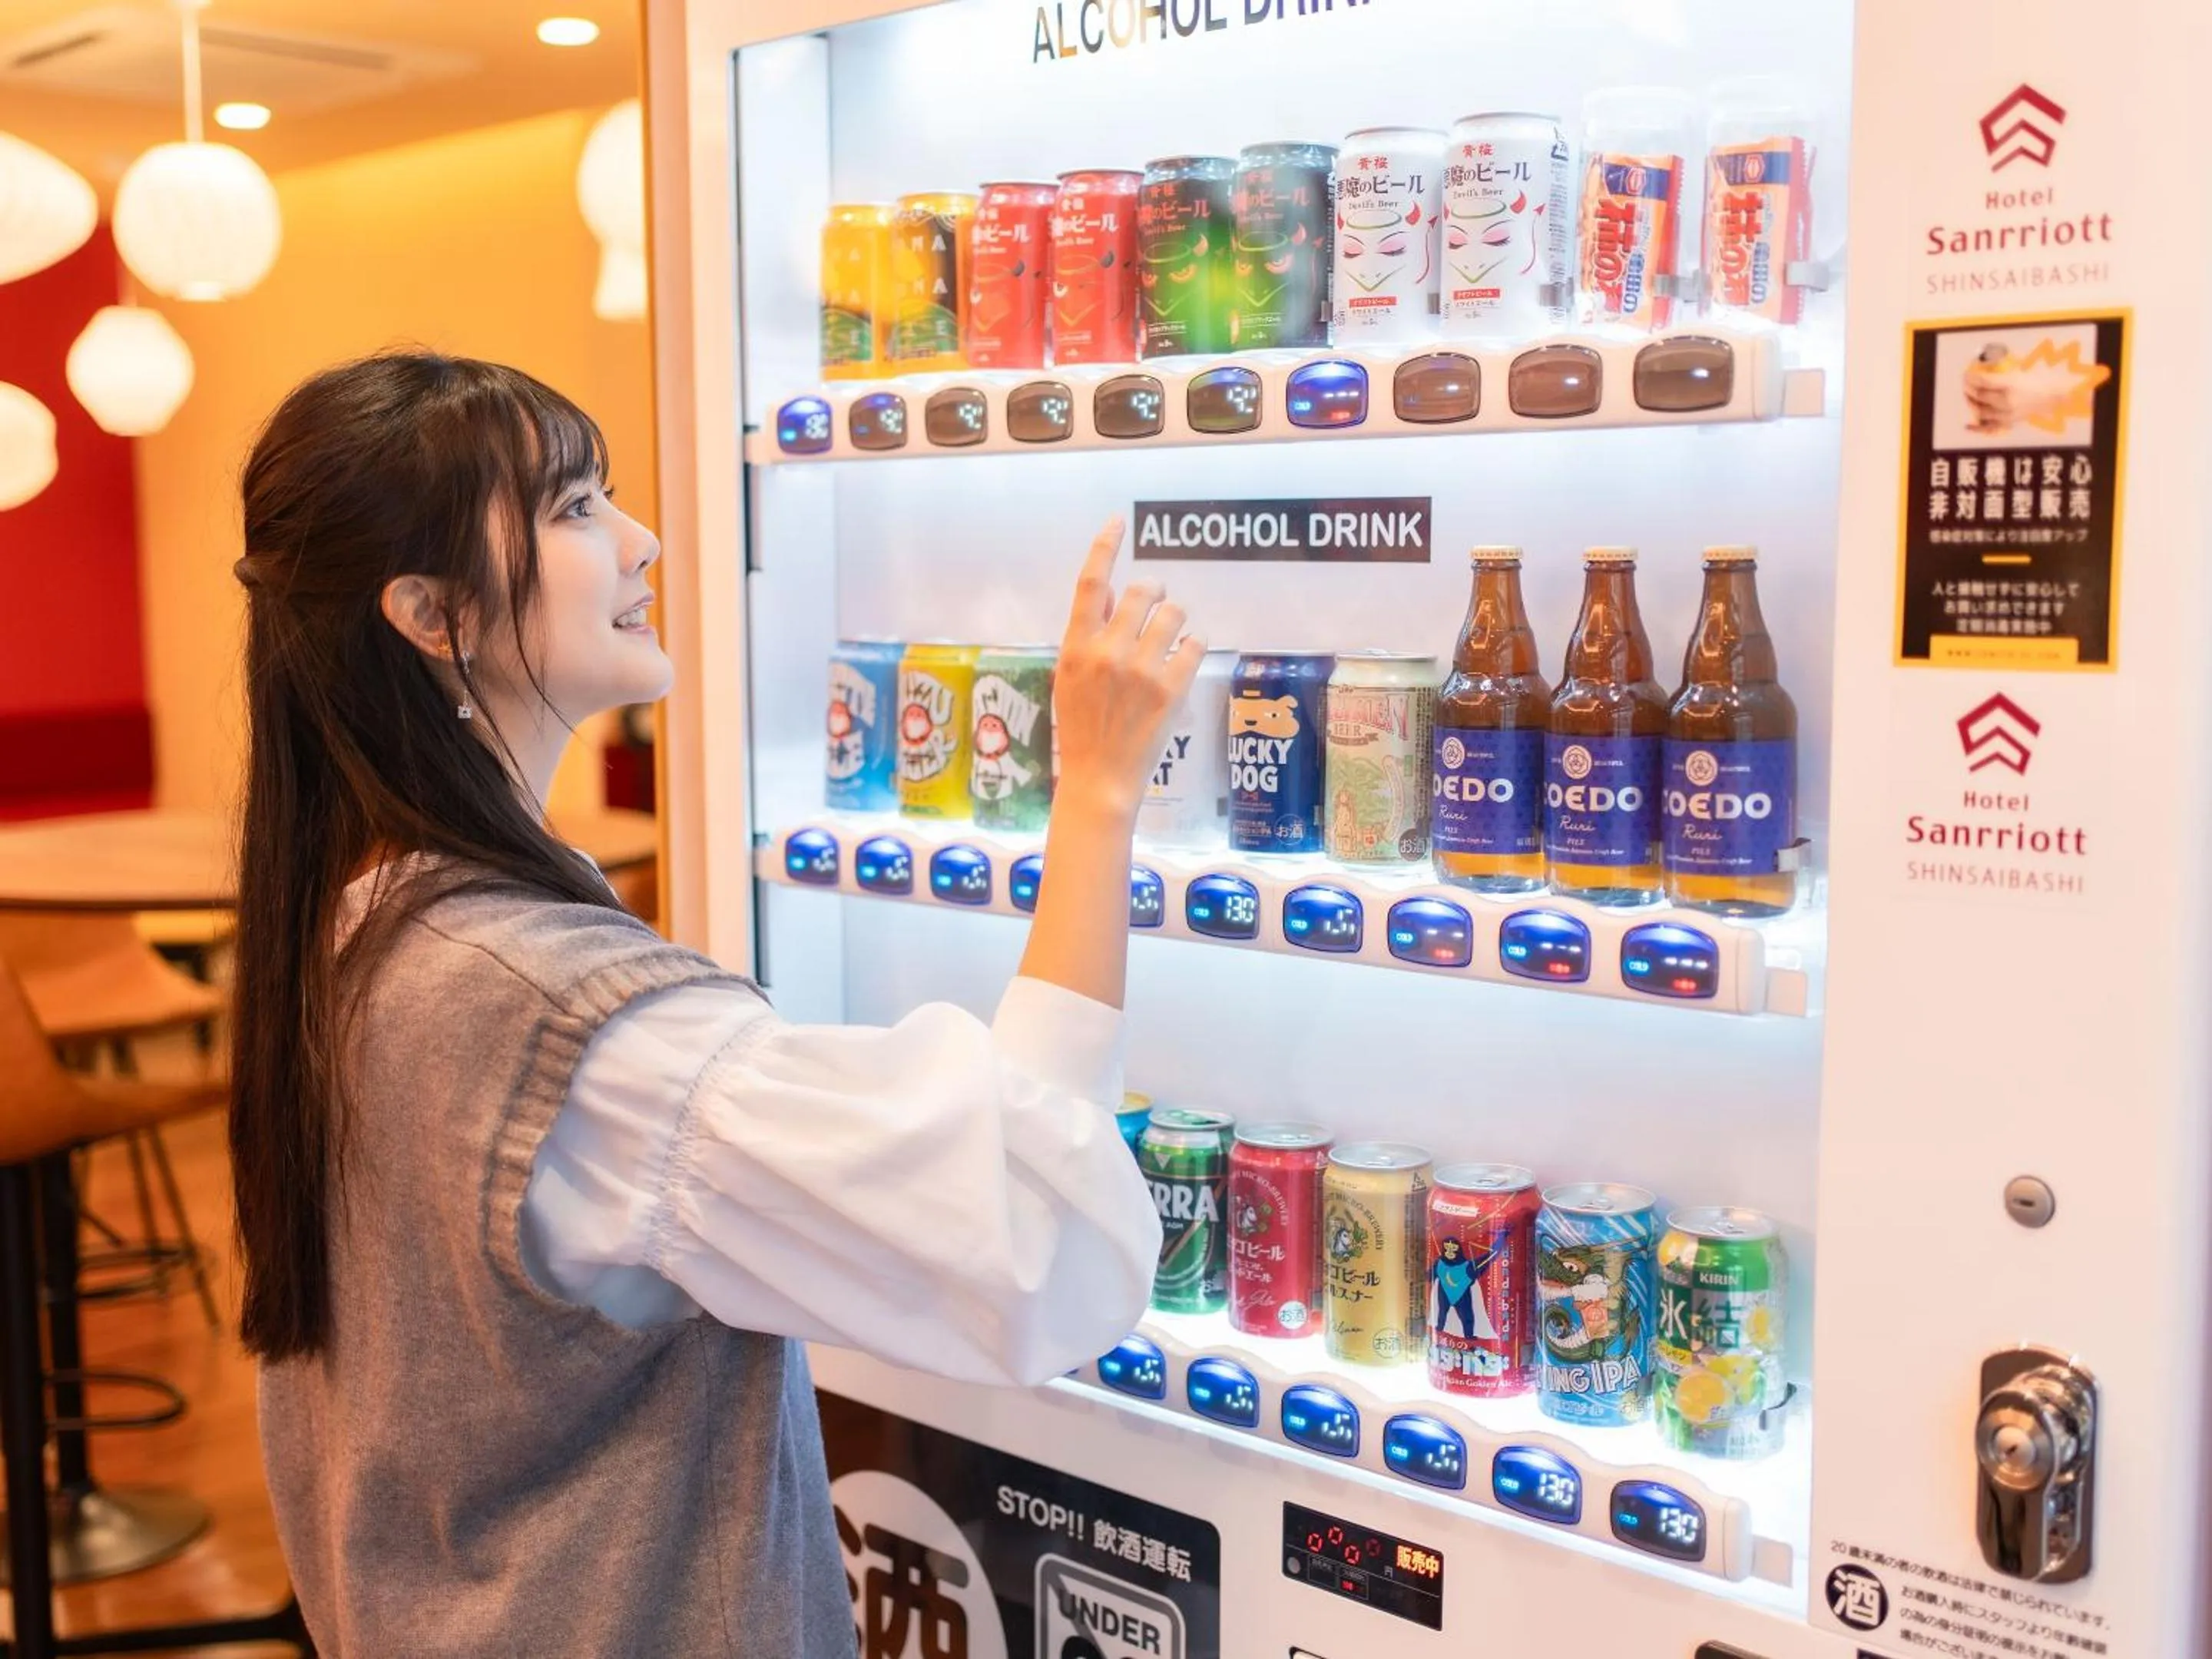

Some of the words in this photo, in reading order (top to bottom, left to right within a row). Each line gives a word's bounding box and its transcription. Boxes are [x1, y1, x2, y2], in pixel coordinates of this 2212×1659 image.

[1985, 187, 2054, 210] Hotel
[1926, 213, 2113, 256] Sanrriott
[1926, 263, 2109, 295] SHINSAIBASHI
[1930, 455, 2093, 487] 自販機は安心
[1929, 489, 2091, 521] 非対面型販売
[1140, 512, 1300, 548] ALCOHOL
[1308, 511, 1423, 548] DRINK
[1228, 737, 1294, 764] UCKY
[1230, 763, 1278, 793] DOG
[1432, 773, 1514, 803] OEDO
[1963, 790, 2030, 812] Hotel
[1906, 815, 2088, 856] Sanrriott
[1906, 860, 2085, 895] SHINSAIBASHI
[1148, 1181, 1220, 1222] RRA
[1699, 1272, 1740, 1286] KIRIN
[1590, 1354, 1642, 1394] IPA
[997, 1485, 1085, 1541] STOP!!
[1094, 1518, 1192, 1583] 飲酒運転
[1396, 1544, 1440, 1579] 販売中
[1833, 1568, 1881, 1627] 酒
[1058, 1587, 1161, 1655] UNDER
